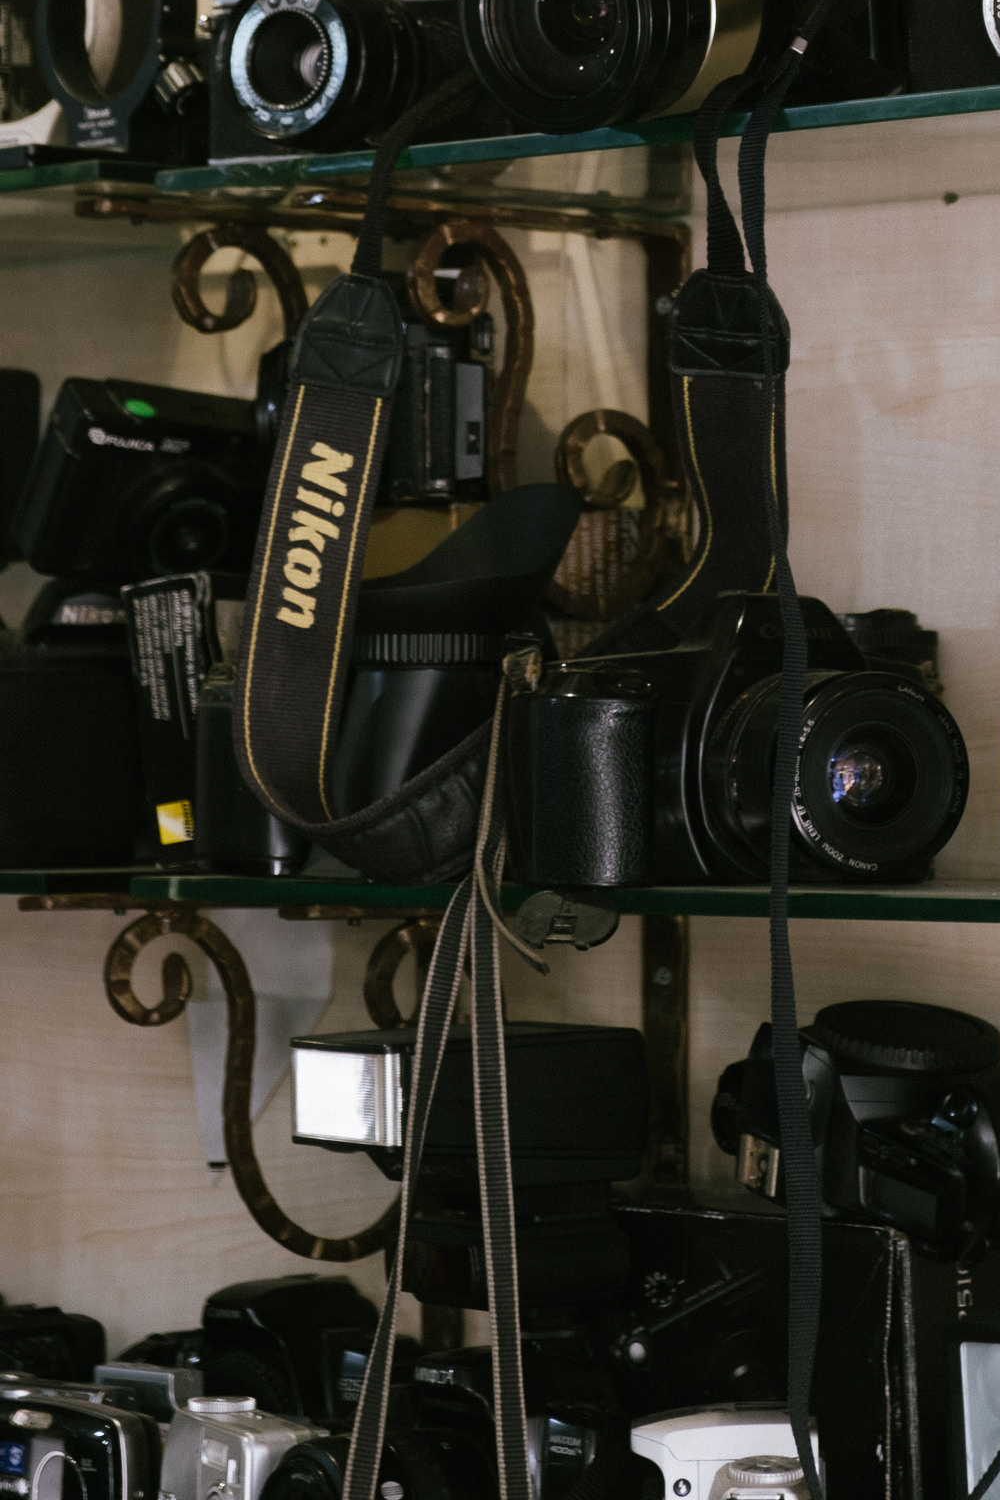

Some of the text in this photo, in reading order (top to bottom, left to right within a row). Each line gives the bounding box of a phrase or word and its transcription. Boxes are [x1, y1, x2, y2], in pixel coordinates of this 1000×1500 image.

[276, 441, 354, 629] Nikon
[804, 820, 821, 841] LENS
[821, 842, 845, 862] ZOOM
[848, 858, 878, 871] CANON
